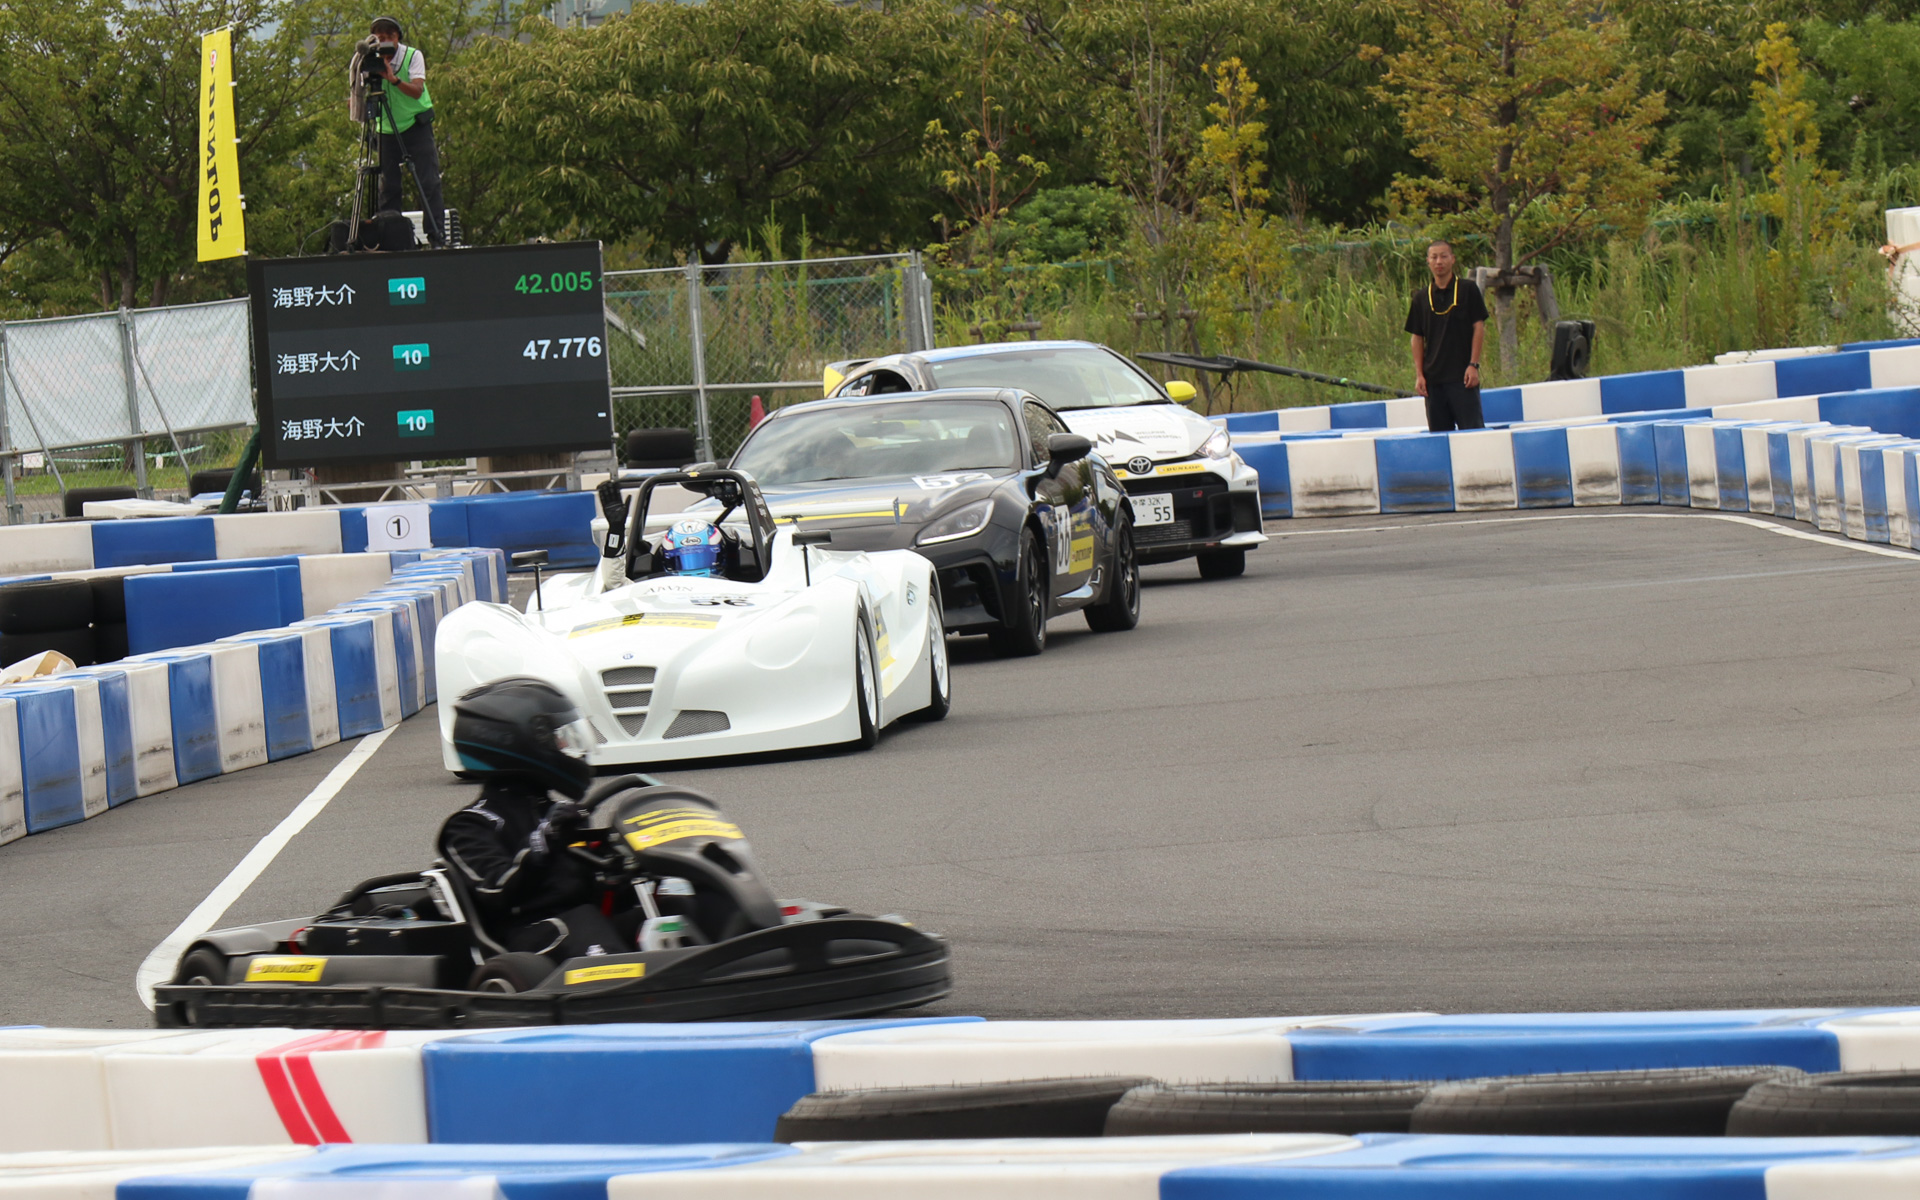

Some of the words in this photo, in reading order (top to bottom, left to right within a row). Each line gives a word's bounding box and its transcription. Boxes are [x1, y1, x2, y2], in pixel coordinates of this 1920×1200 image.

[272, 283, 356, 308] 海野大介
[397, 283, 418, 299] 10
[514, 271, 593, 294] 42.005
[277, 349, 361, 374] 海野大介
[401, 349, 422, 365] 10
[523, 336, 602, 360] 47.776
[281, 415, 365, 441] 海野大介
[406, 415, 427, 431] 10
[1166, 464, 1200, 473] DUNLOP
[1153, 505, 1171, 522] 55
[690, 598, 756, 607] 56
